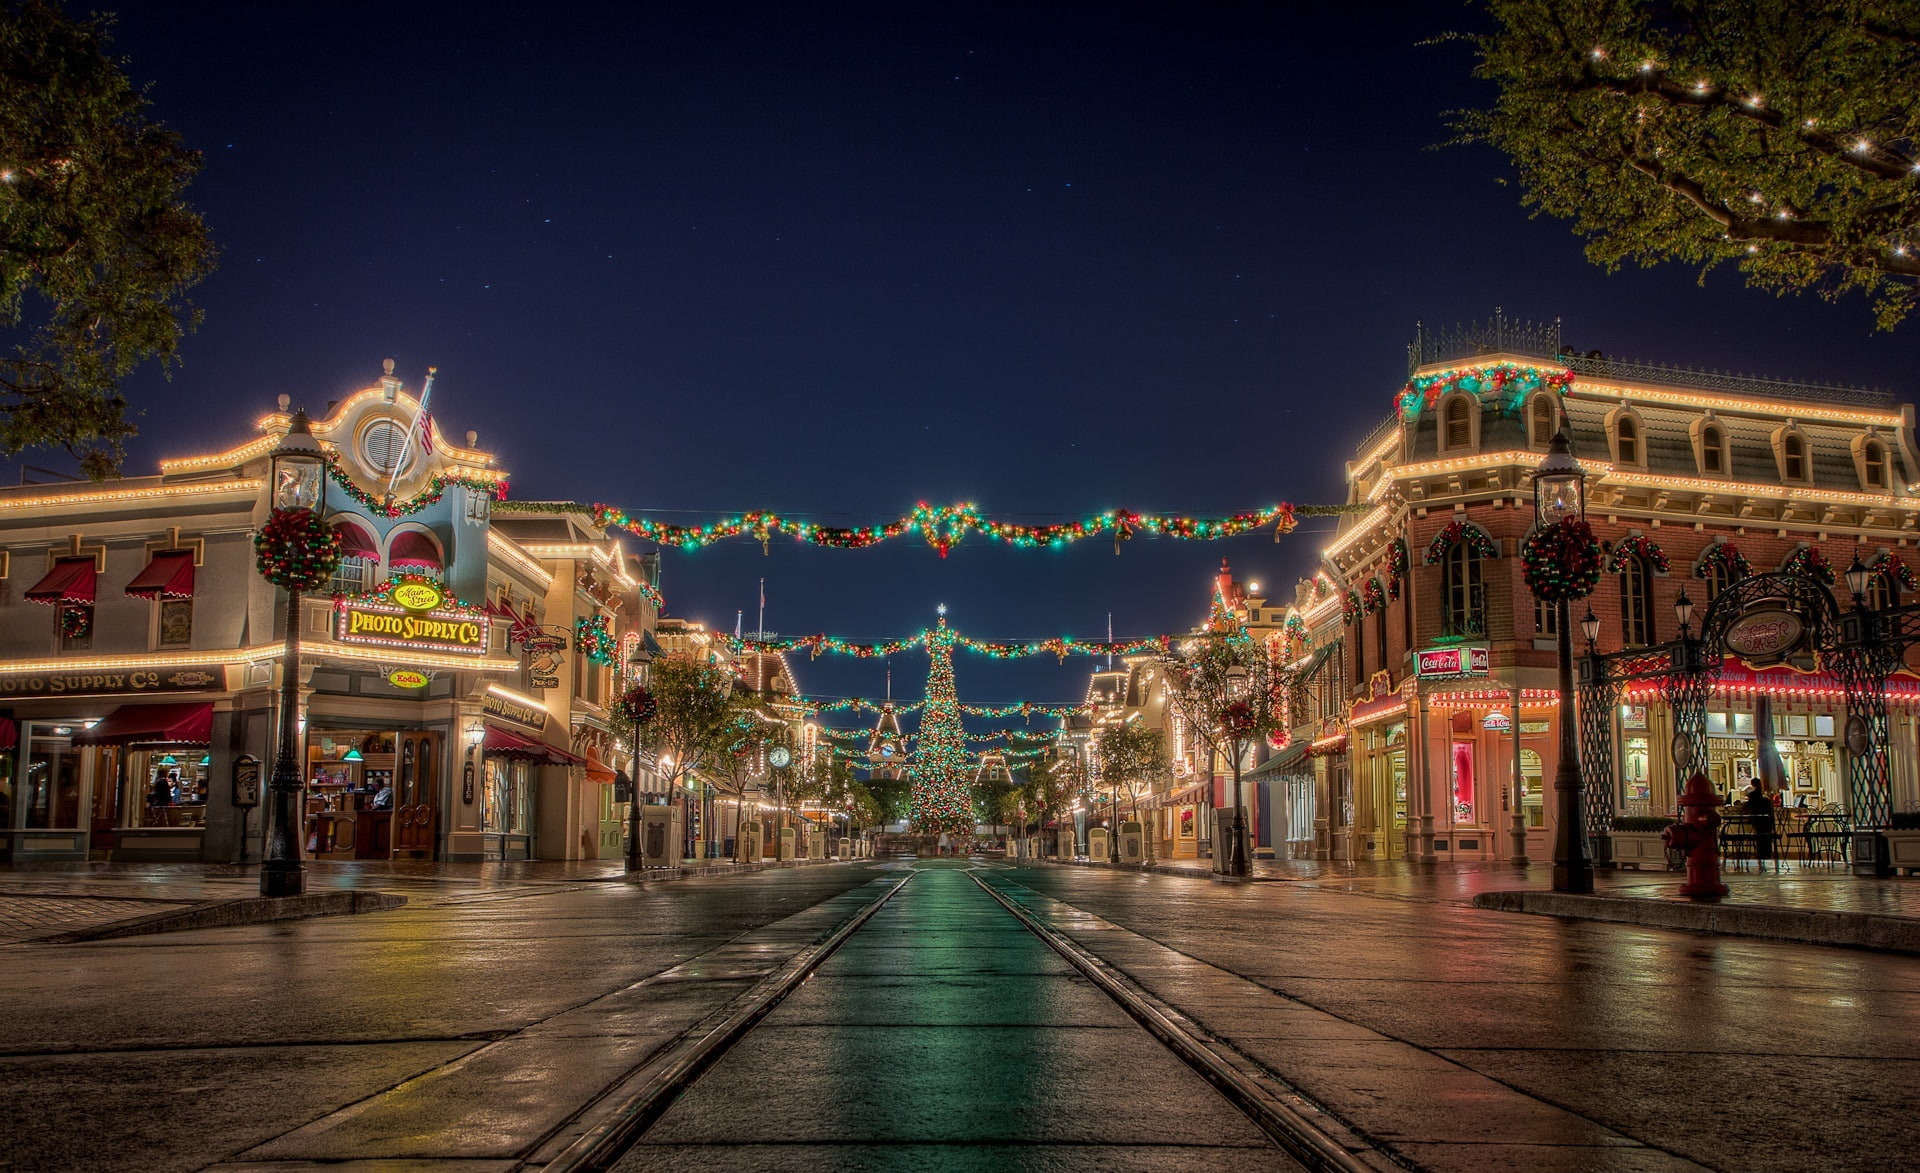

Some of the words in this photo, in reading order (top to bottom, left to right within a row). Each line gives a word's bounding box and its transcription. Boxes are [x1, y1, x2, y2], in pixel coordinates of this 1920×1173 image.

[400, 587, 430, 597] Main
[408, 595, 436, 607] Street
[350, 611, 403, 633] PHOTO
[402, 617, 460, 640] SUPPLY
[1732, 621, 1789, 641] CORNER
[0, 678, 45, 692] OTO
[50, 674, 125, 692] SUPPLY
[397, 674, 421, 684] Kodak
